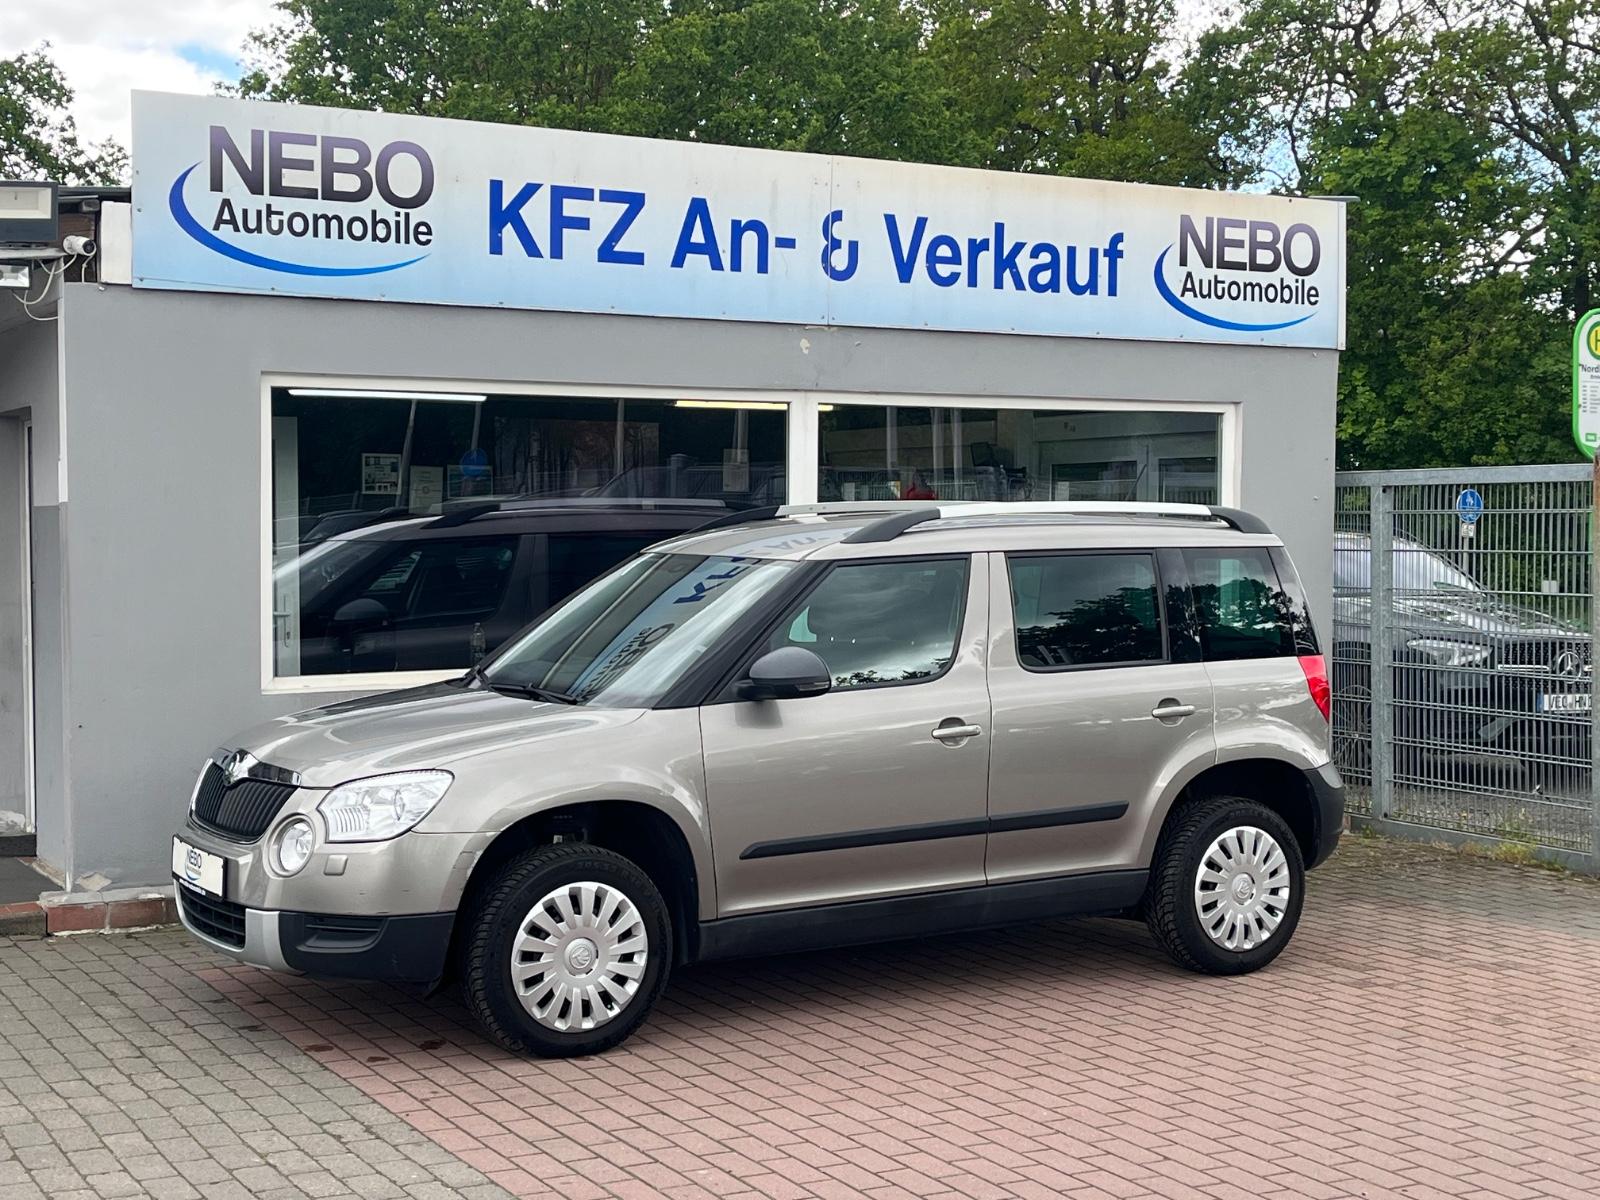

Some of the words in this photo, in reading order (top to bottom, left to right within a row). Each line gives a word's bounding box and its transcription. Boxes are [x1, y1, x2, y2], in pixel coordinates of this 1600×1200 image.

[208, 125, 435, 210] NEBO
[212, 197, 434, 247] Automobile
[489, 179, 646, 266] KFZ
[670, 197, 798, 275] An-
[821, 209, 859, 282] &
[883, 213, 1124, 297] Verkauf
[1178, 214, 1321, 277] NEBO
[1180, 270, 1320, 306] Automobile
